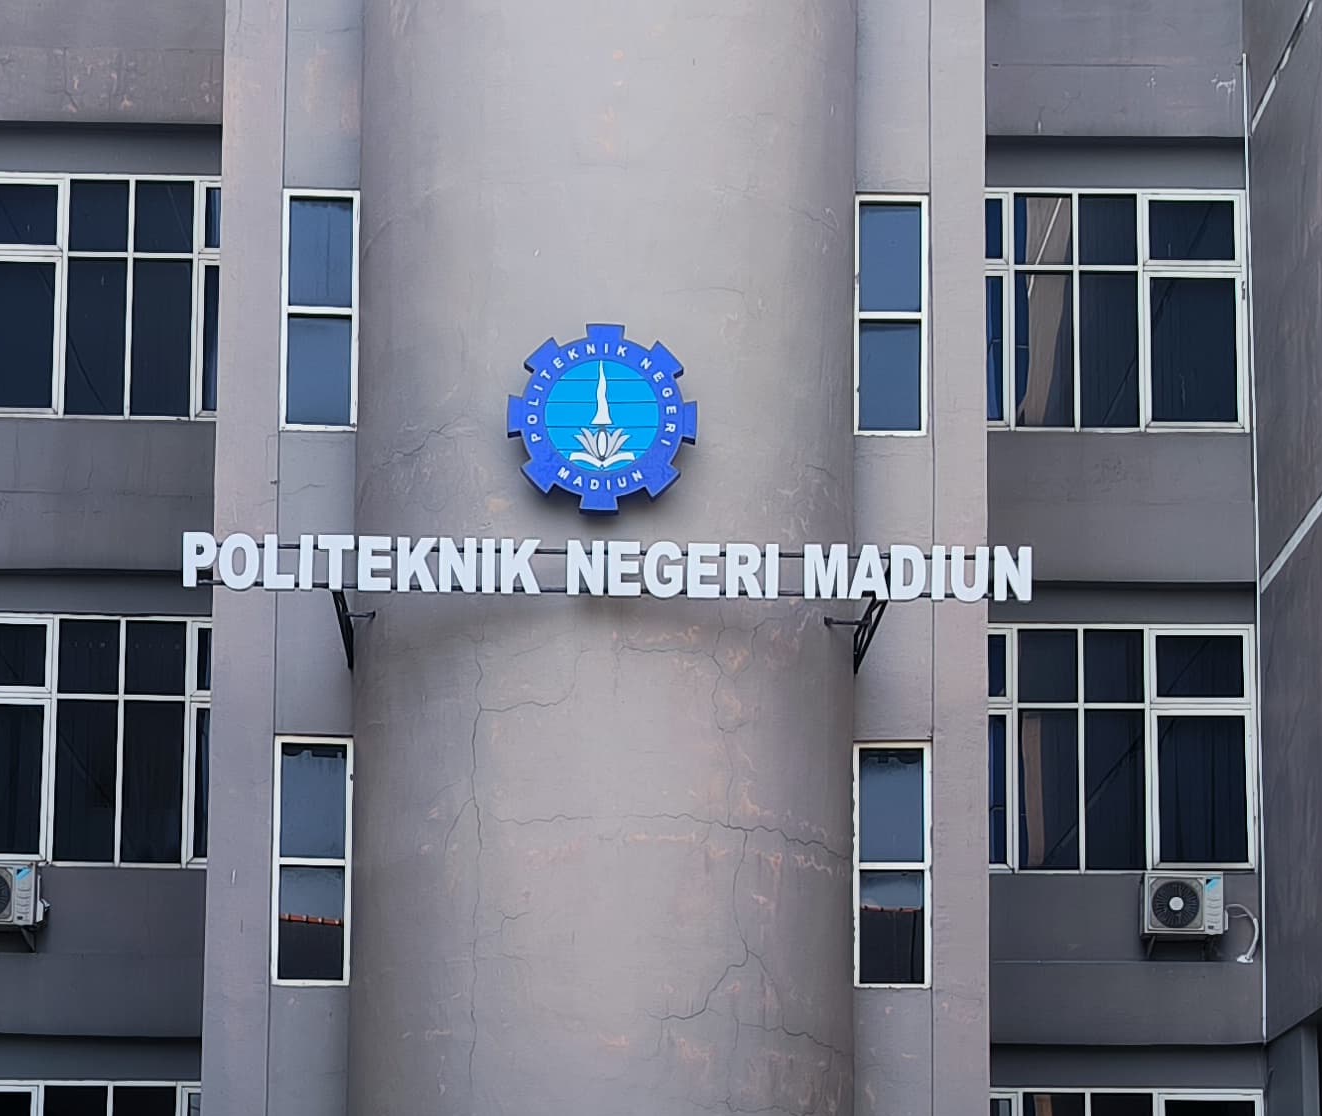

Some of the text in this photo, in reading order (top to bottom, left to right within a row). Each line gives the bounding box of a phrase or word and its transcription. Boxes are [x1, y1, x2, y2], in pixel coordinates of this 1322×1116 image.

[527, 343, 678, 447] POLITEKNIK NEGERI
[557, 466, 644, 491] MADIUN
[182, 530, 1034, 603] POLITEKNIK NEGERI MADIUN
